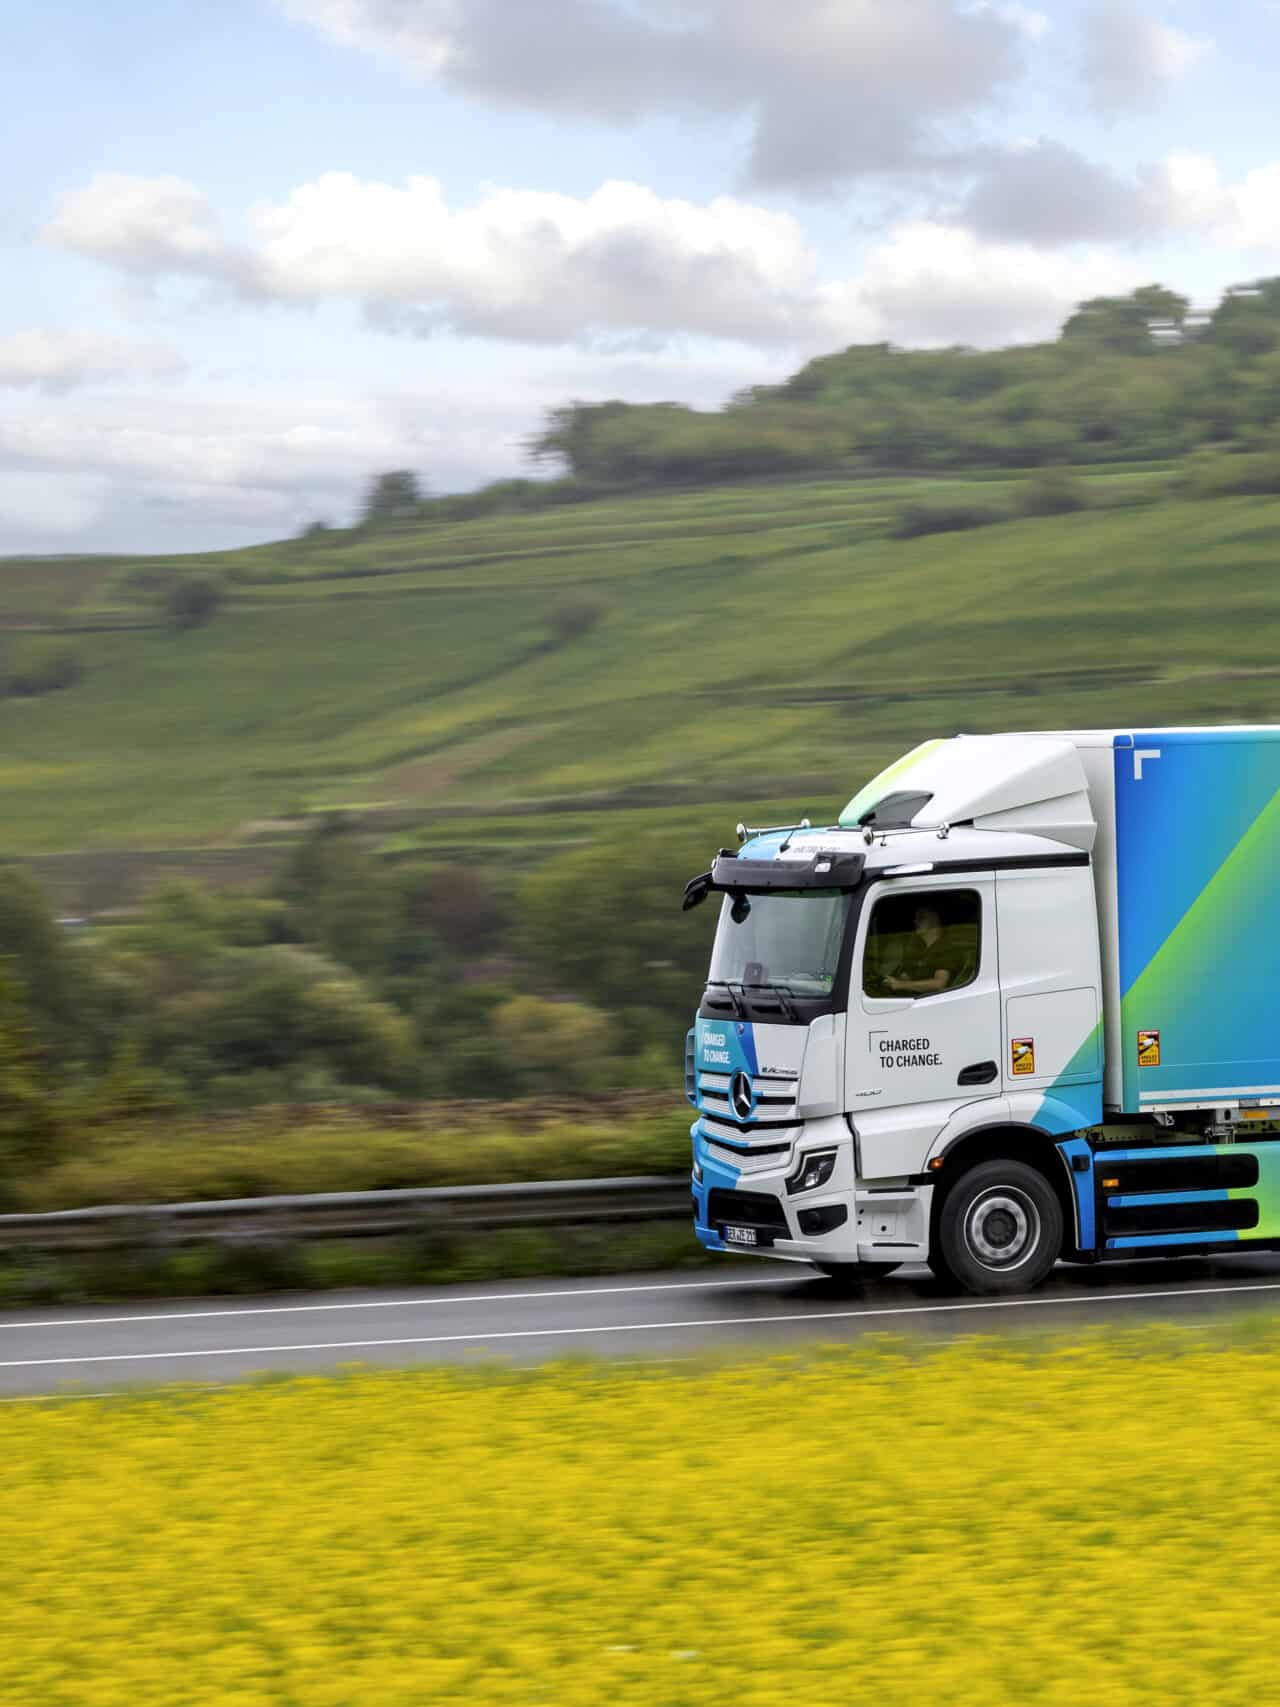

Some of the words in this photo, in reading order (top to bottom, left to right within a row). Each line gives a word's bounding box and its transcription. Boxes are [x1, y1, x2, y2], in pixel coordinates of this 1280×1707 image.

[880, 1038, 930, 1052] CHARGED
[880, 1056, 894, 1068] TO
[896, 1053, 943, 1068] CHANGE.
